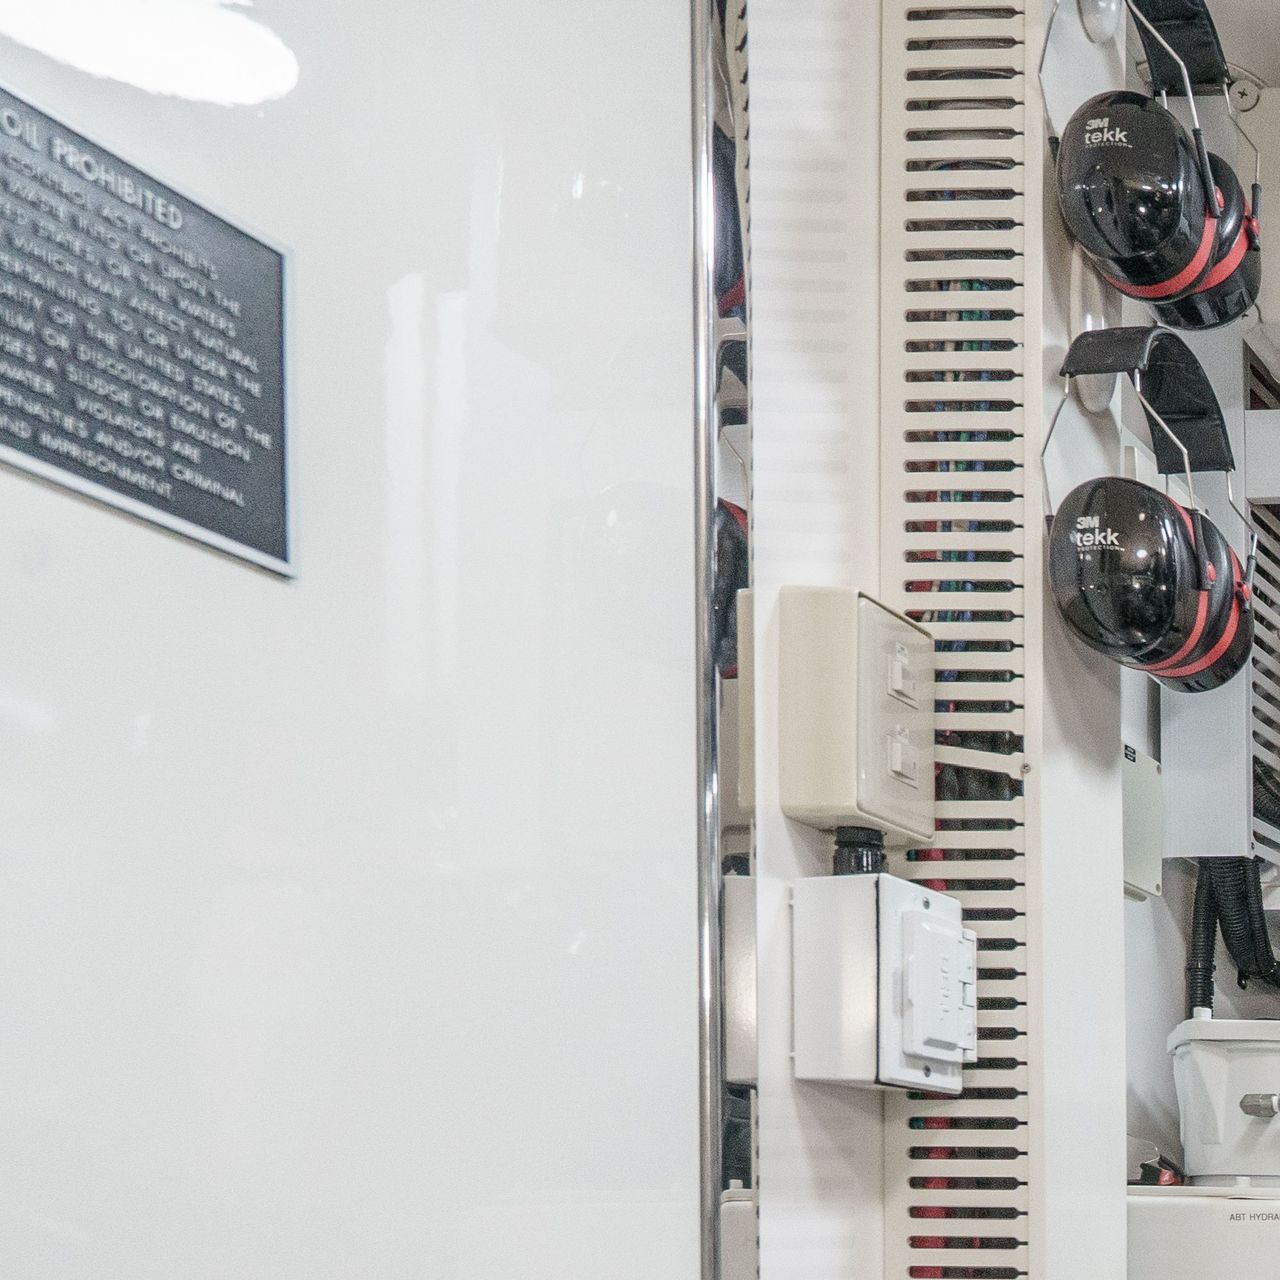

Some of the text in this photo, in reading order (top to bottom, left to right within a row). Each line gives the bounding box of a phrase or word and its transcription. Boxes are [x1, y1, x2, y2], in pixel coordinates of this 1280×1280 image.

[1084, 127, 1128, 144] tekk
[1085, 118, 1109, 130] 3M
[2, 105, 182, 233] OIL PROHIBITED
[7, 149, 218, 281] CONTROL ACT PROHIBITS
[9, 177, 240, 317] WASTE INTO OR UPON THE
[13, 232, 258, 373] WHICH MAY AFFECT NATURAL
[109, 257, 130, 283] OR
[141, 273, 167, 302] THE
[178, 293, 235, 338] WATERS
[52, 304, 75, 331] OF
[86, 321, 117, 351] THE
[126, 340, 185, 384] UNITED
[144, 325, 167, 351] OR
[176, 341, 226, 380] UNDER
[235, 370, 261, 398] THE
[43, 326, 68, 355] OR
[77, 342, 209, 420] DISCOLORATION
[217, 408, 236, 432] OF
[245, 421, 271, 449] THE
[66, 363, 131, 408] SLUDGE
[140, 396, 163, 422] OR
[170, 410, 250, 461] EMULSION
[76, 392, 165, 447] VIOLATORS
[171, 434, 200, 463] ARE
[95, 426, 165, 472] AND/OR
[171, 459, 244, 505] CRIMINAL
[1076, 516, 1100, 529] 3M
[1076, 528, 1119, 546] tekk
[1230, 1213, 1246, 1221] ABT
